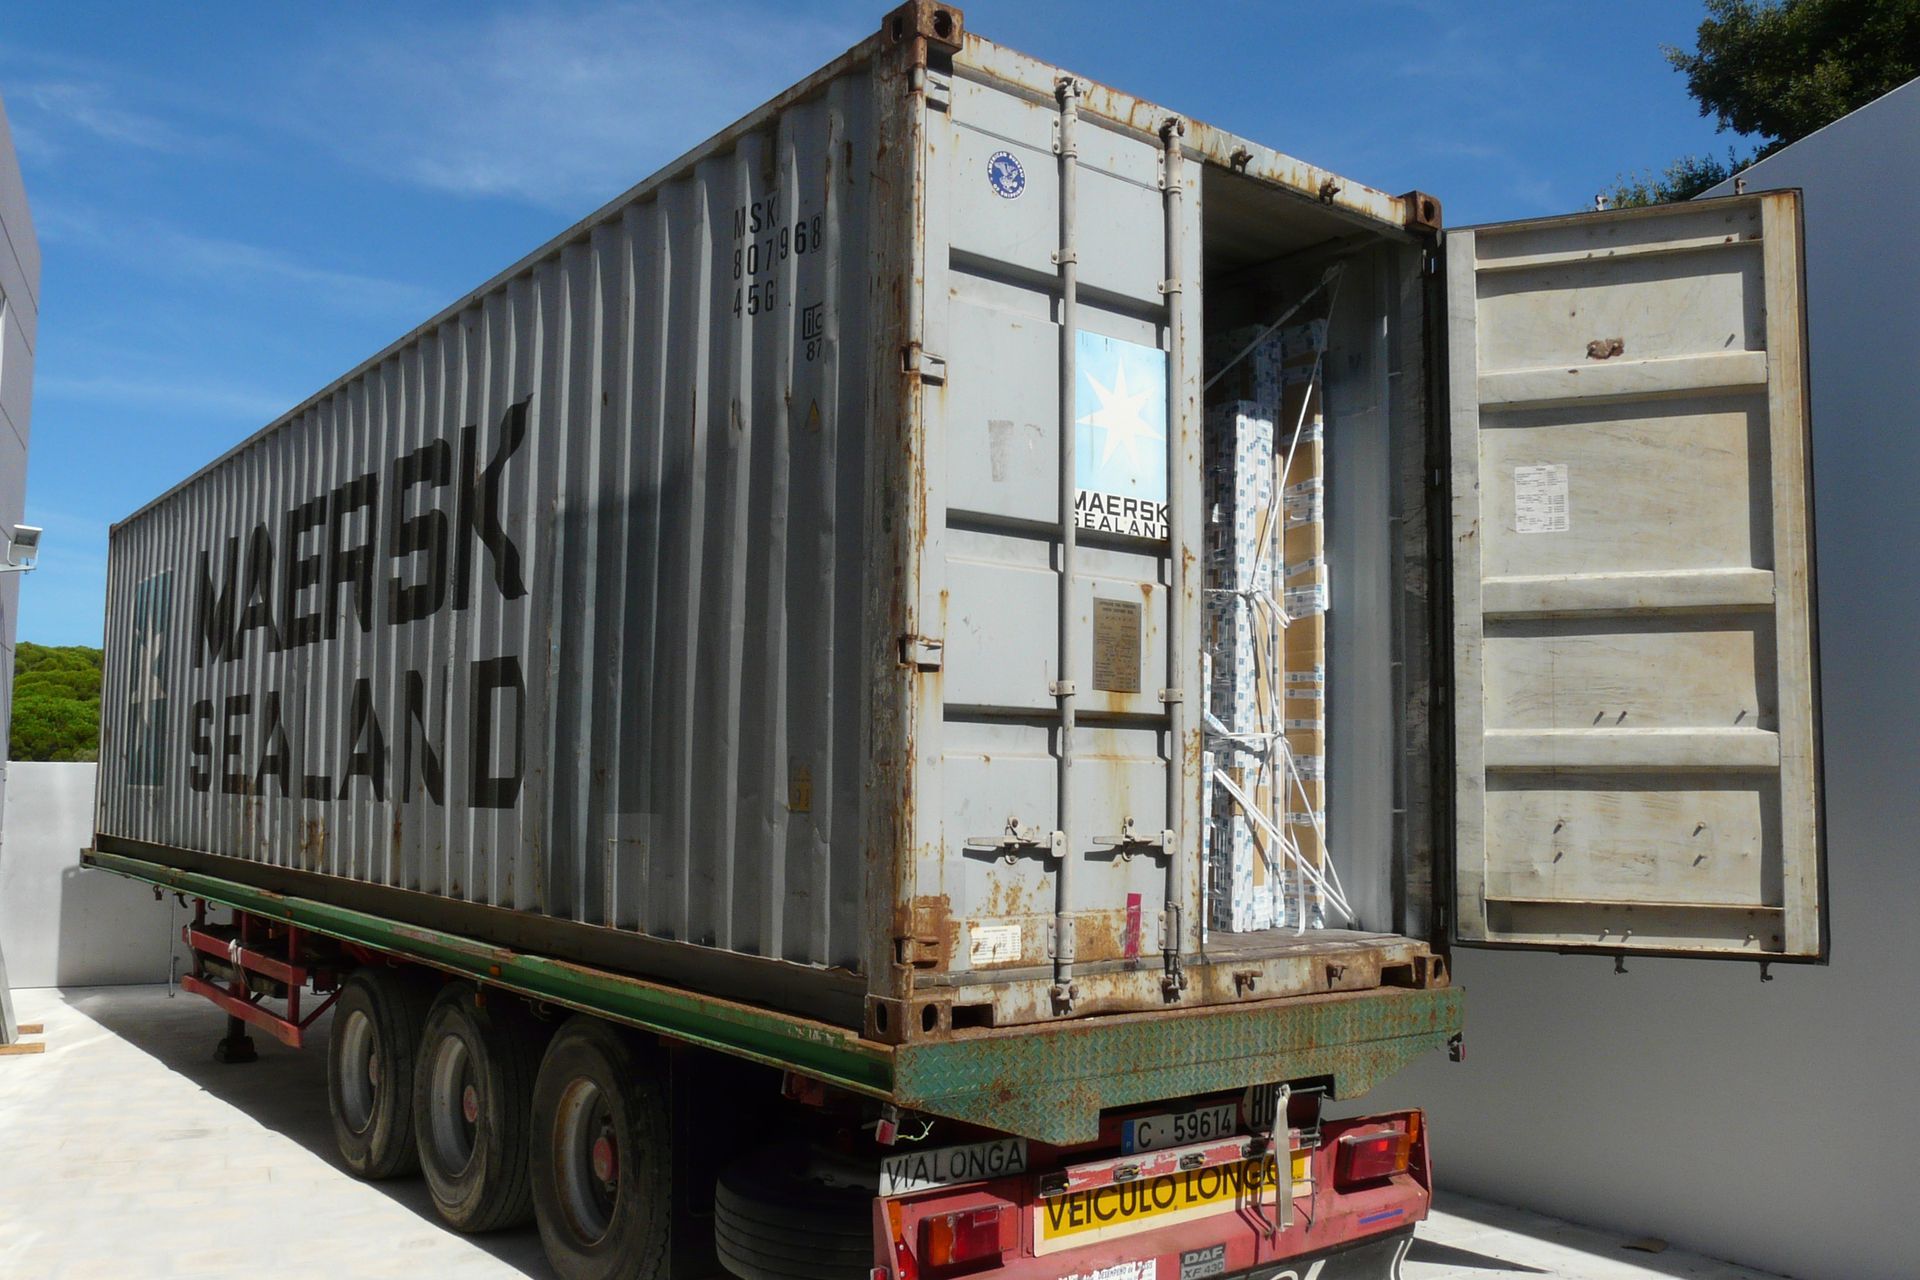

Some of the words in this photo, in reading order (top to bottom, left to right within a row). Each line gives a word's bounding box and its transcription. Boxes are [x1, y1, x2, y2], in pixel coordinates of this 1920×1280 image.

[1075, 491, 1170, 525] MAERSK
[195, 393, 534, 669] MAERSK
[190, 655, 526, 809] SEALAND
[1174, 1108, 1232, 1142] 59614
[886, 1141, 1024, 1193] VIALONGA
[1045, 1176, 1177, 1231] VEICULO
[1184, 1246, 1224, 1265] DAF
[1184, 1266, 1201, 1279] XF
